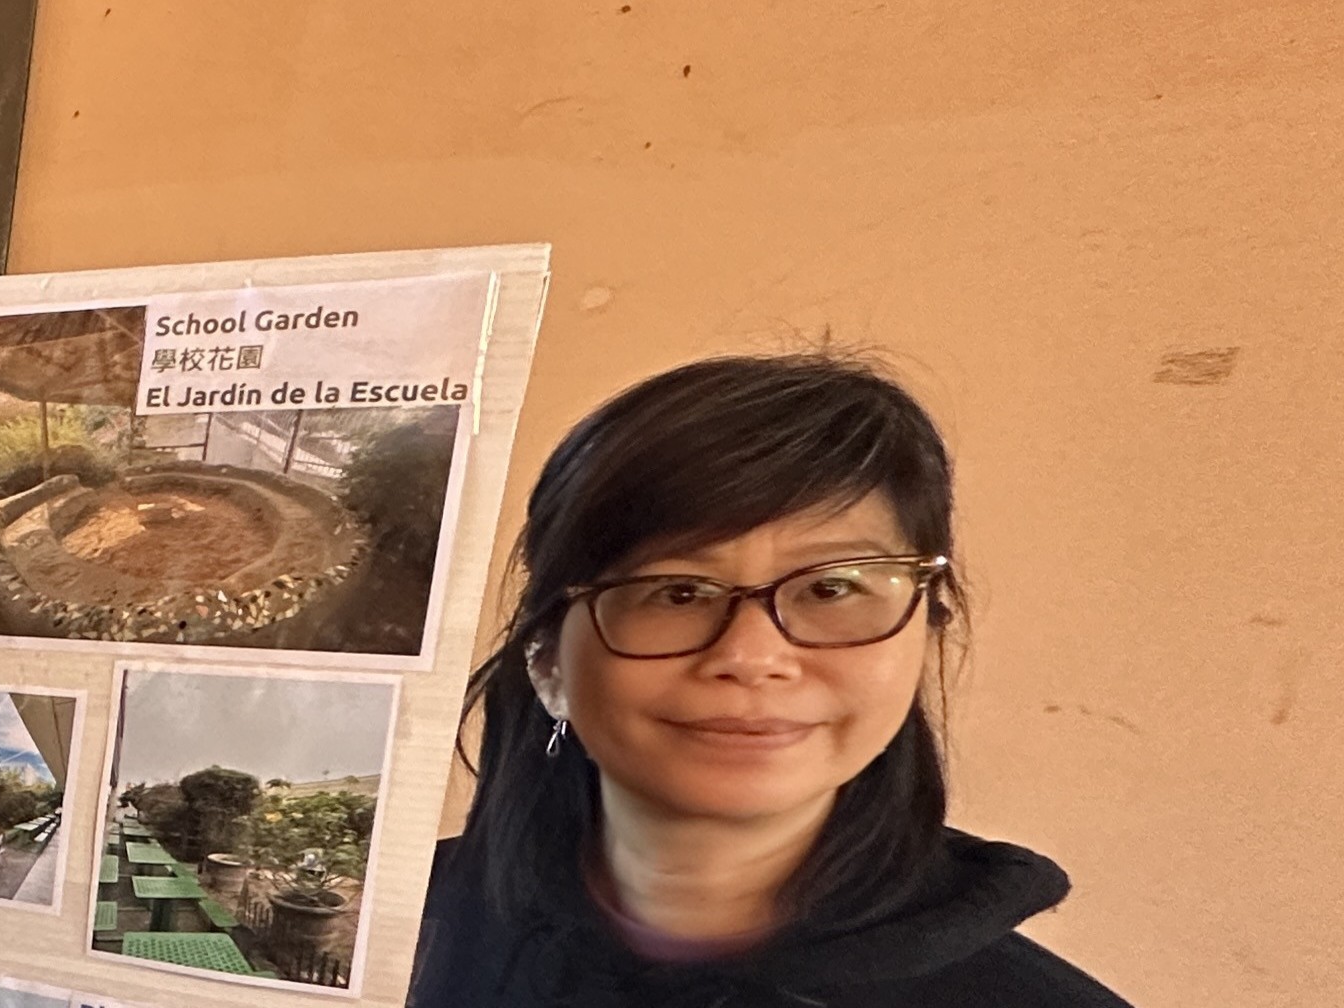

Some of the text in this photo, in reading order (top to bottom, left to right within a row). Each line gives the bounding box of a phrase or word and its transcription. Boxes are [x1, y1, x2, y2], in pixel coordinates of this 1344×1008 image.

[155, 307, 359, 337] School Garden
[151, 345, 263, 373] 學校花園
[146, 378, 468, 408] El Jardín de la Escuela
